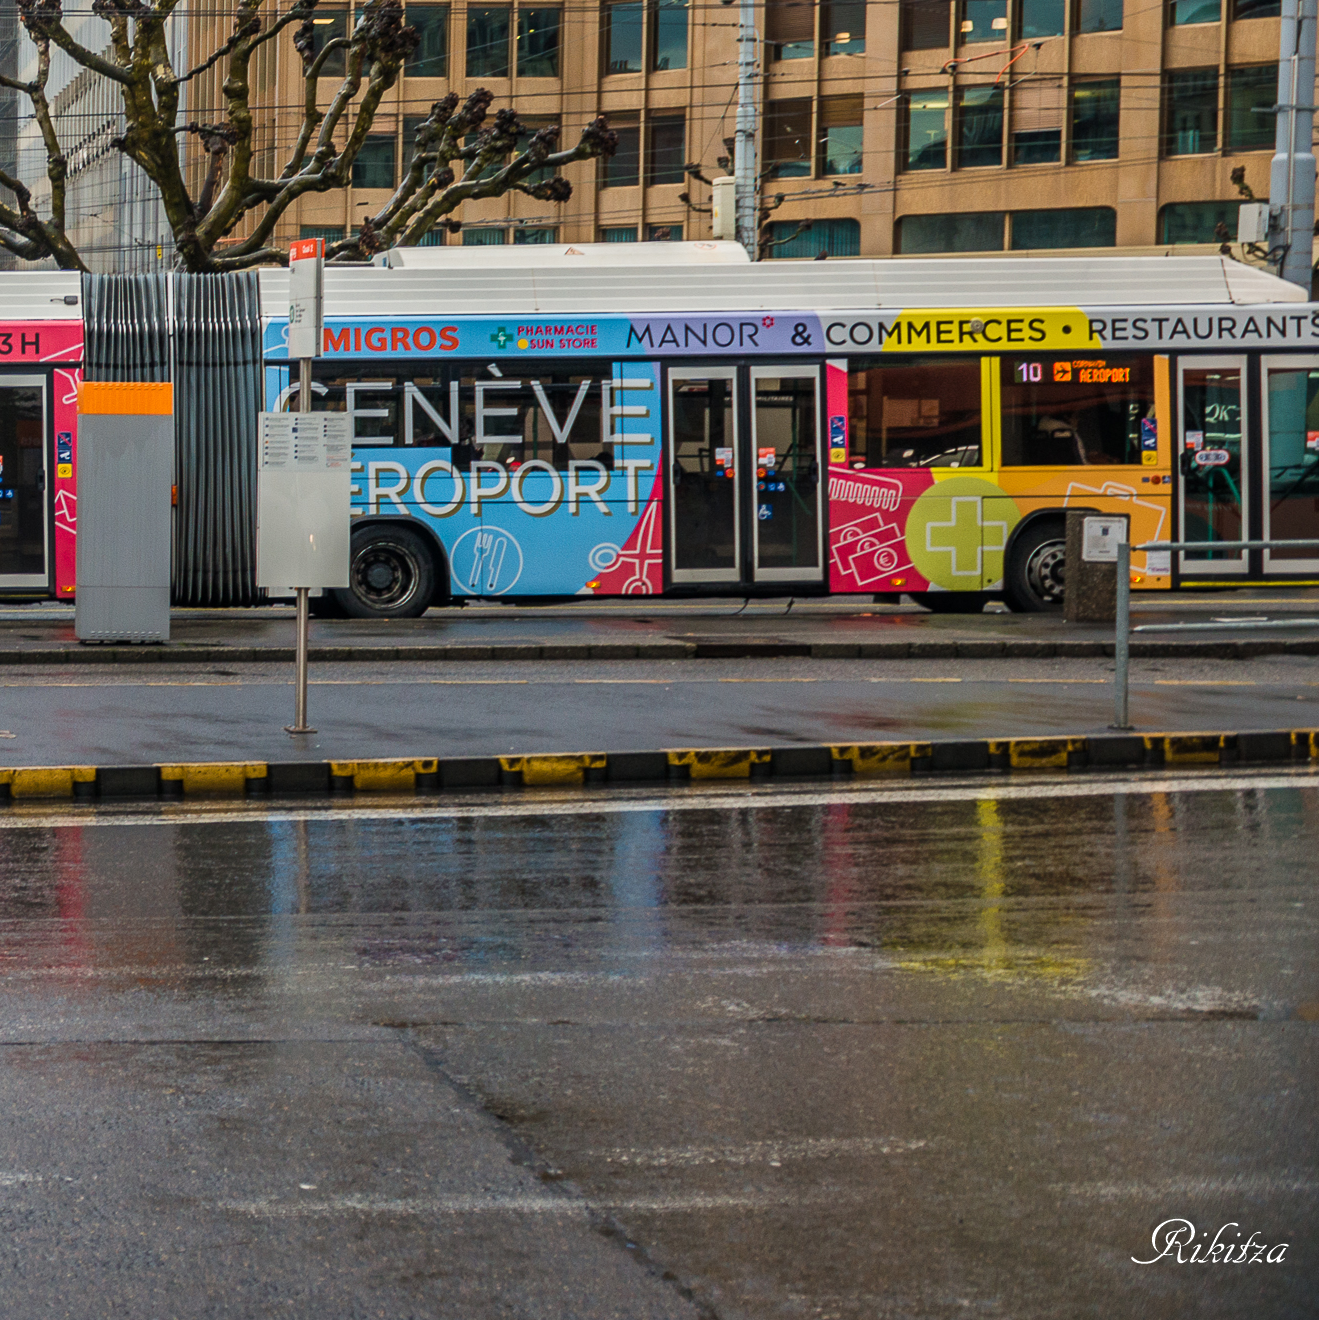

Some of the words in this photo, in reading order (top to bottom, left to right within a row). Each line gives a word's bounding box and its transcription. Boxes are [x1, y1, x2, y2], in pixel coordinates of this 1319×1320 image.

[323, 326, 460, 352] MIGROS
[517, 324, 598, 337] PHARMACIE
[626, 322, 760, 348] MANOR
[791, 322, 812, 347] &
[825, 318, 1047, 346] COMMERCES
[530, 338, 555, 349] SUN
[559, 337, 598, 349] STORE
[1018, 362, 1042, 382] 10
[1079, 368, 1130, 382] AEROPORT
